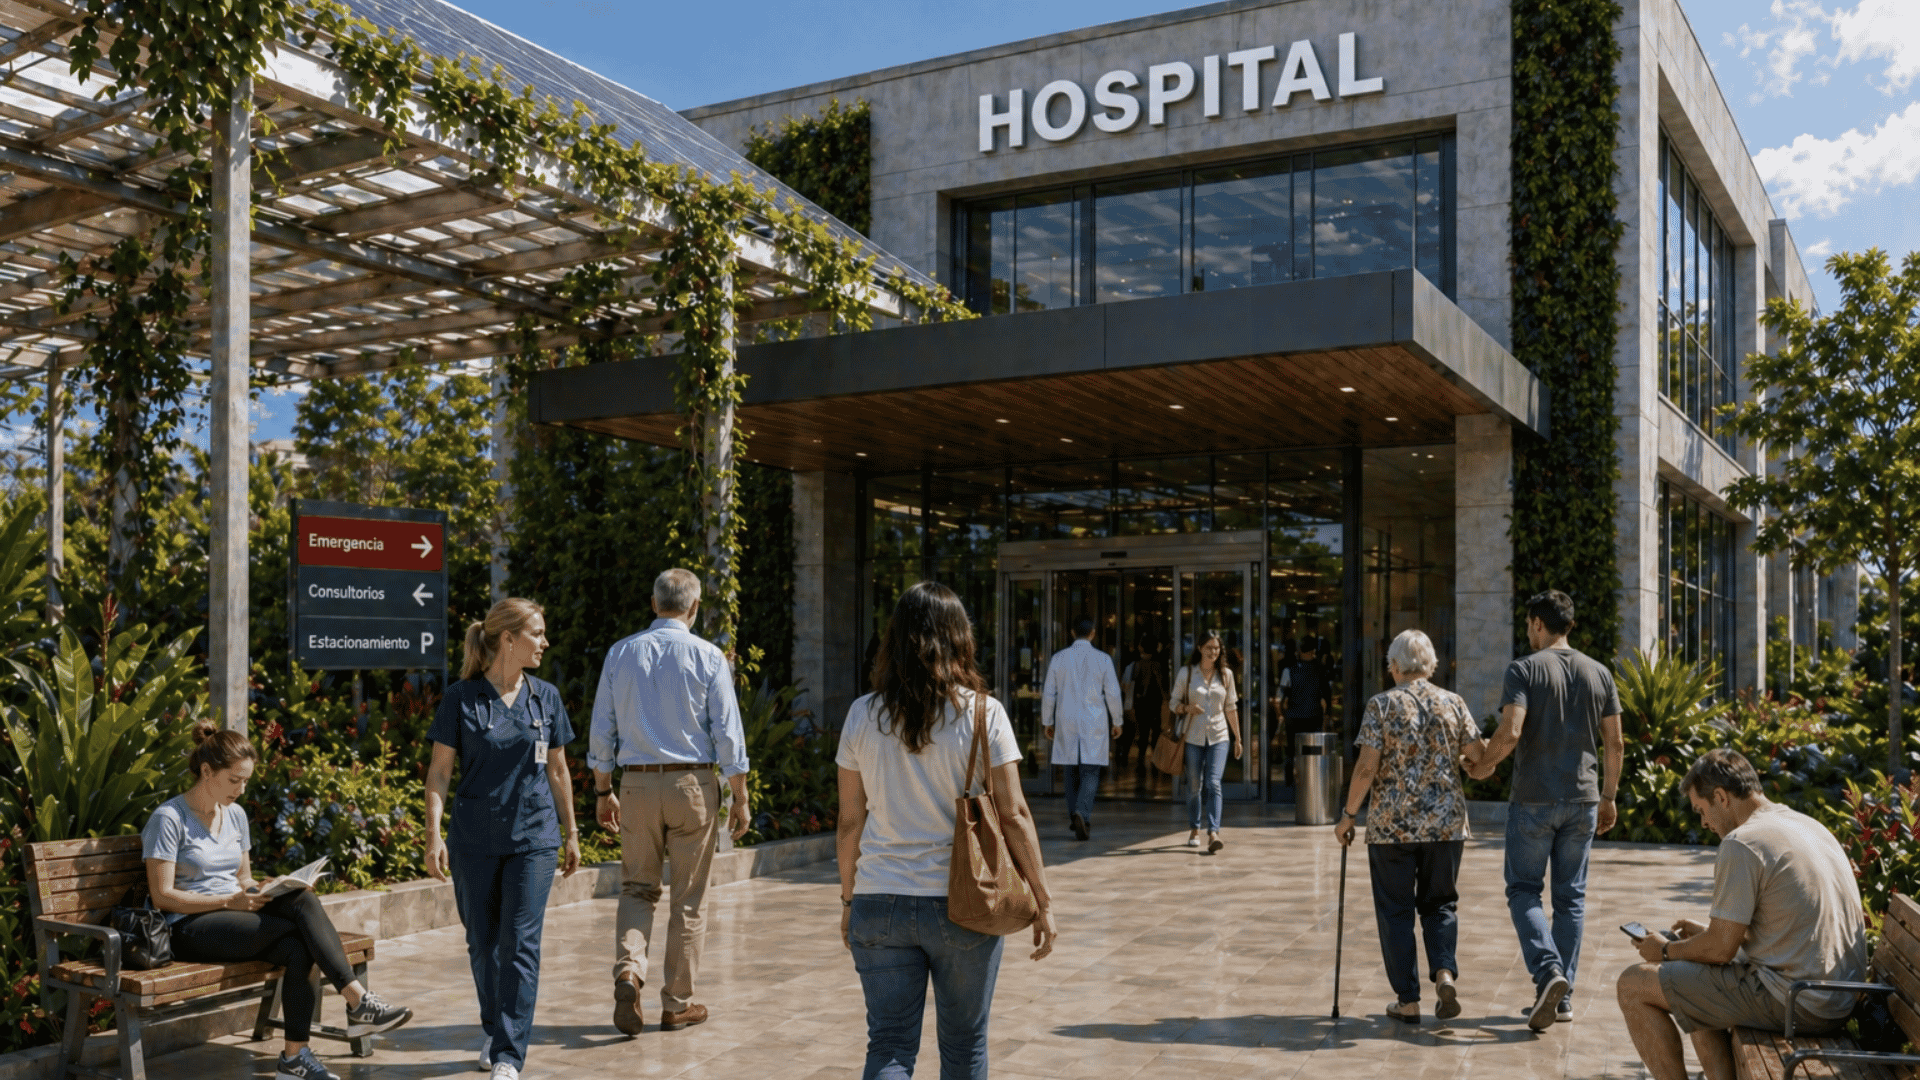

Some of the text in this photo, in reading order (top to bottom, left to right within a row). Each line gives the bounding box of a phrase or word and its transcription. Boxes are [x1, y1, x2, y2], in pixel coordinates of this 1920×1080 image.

[979, 31, 1384, 153] HOSPITAL
[308, 533, 385, 553] Emergencia
[308, 583, 386, 601] Consultorios
[308, 631, 435, 655] Estacionamiento P
